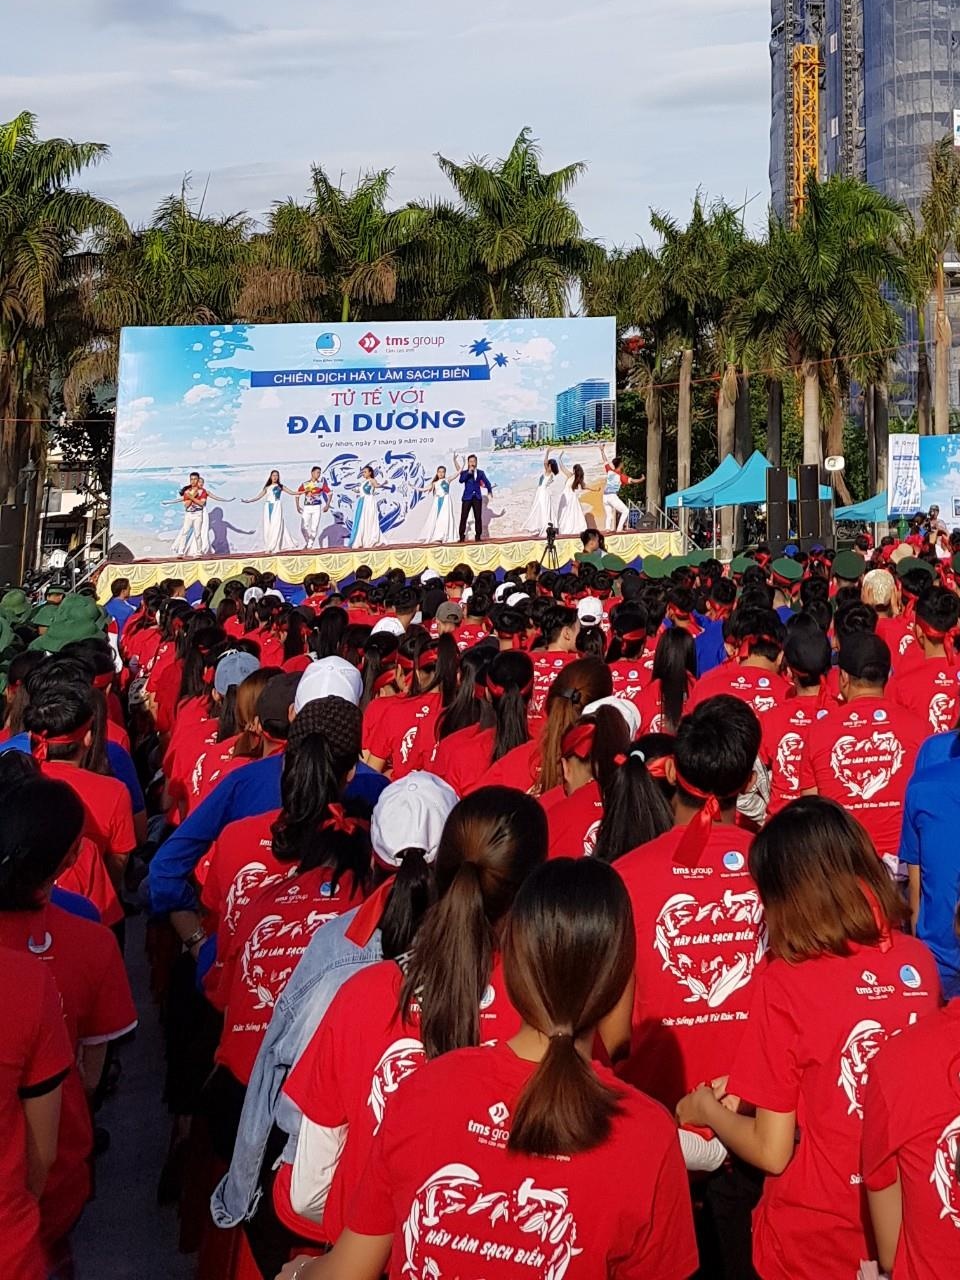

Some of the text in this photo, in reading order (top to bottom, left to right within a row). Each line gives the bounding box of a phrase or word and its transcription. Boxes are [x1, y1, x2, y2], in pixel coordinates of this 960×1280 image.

[386, 334, 445, 350] tms group
[316, 372, 347, 384] DỊCH
[350, 369, 375, 381] HÃY
[377, 369, 403, 381] LÀM
[406, 369, 440, 381] SẠCH
[331, 386, 425, 407] TỬ TẾ VỚI
[286, 408, 466, 439] ĐẠI DƯƠNG
[672, 867, 689, 875] tms
[690, 867, 713, 875] group
[674, 933, 691, 947] HÃY
[468, 1119, 510, 1141] tms gro
[425, 1229, 546, 1268] HÃY LÀM SẠCH BIỂN
